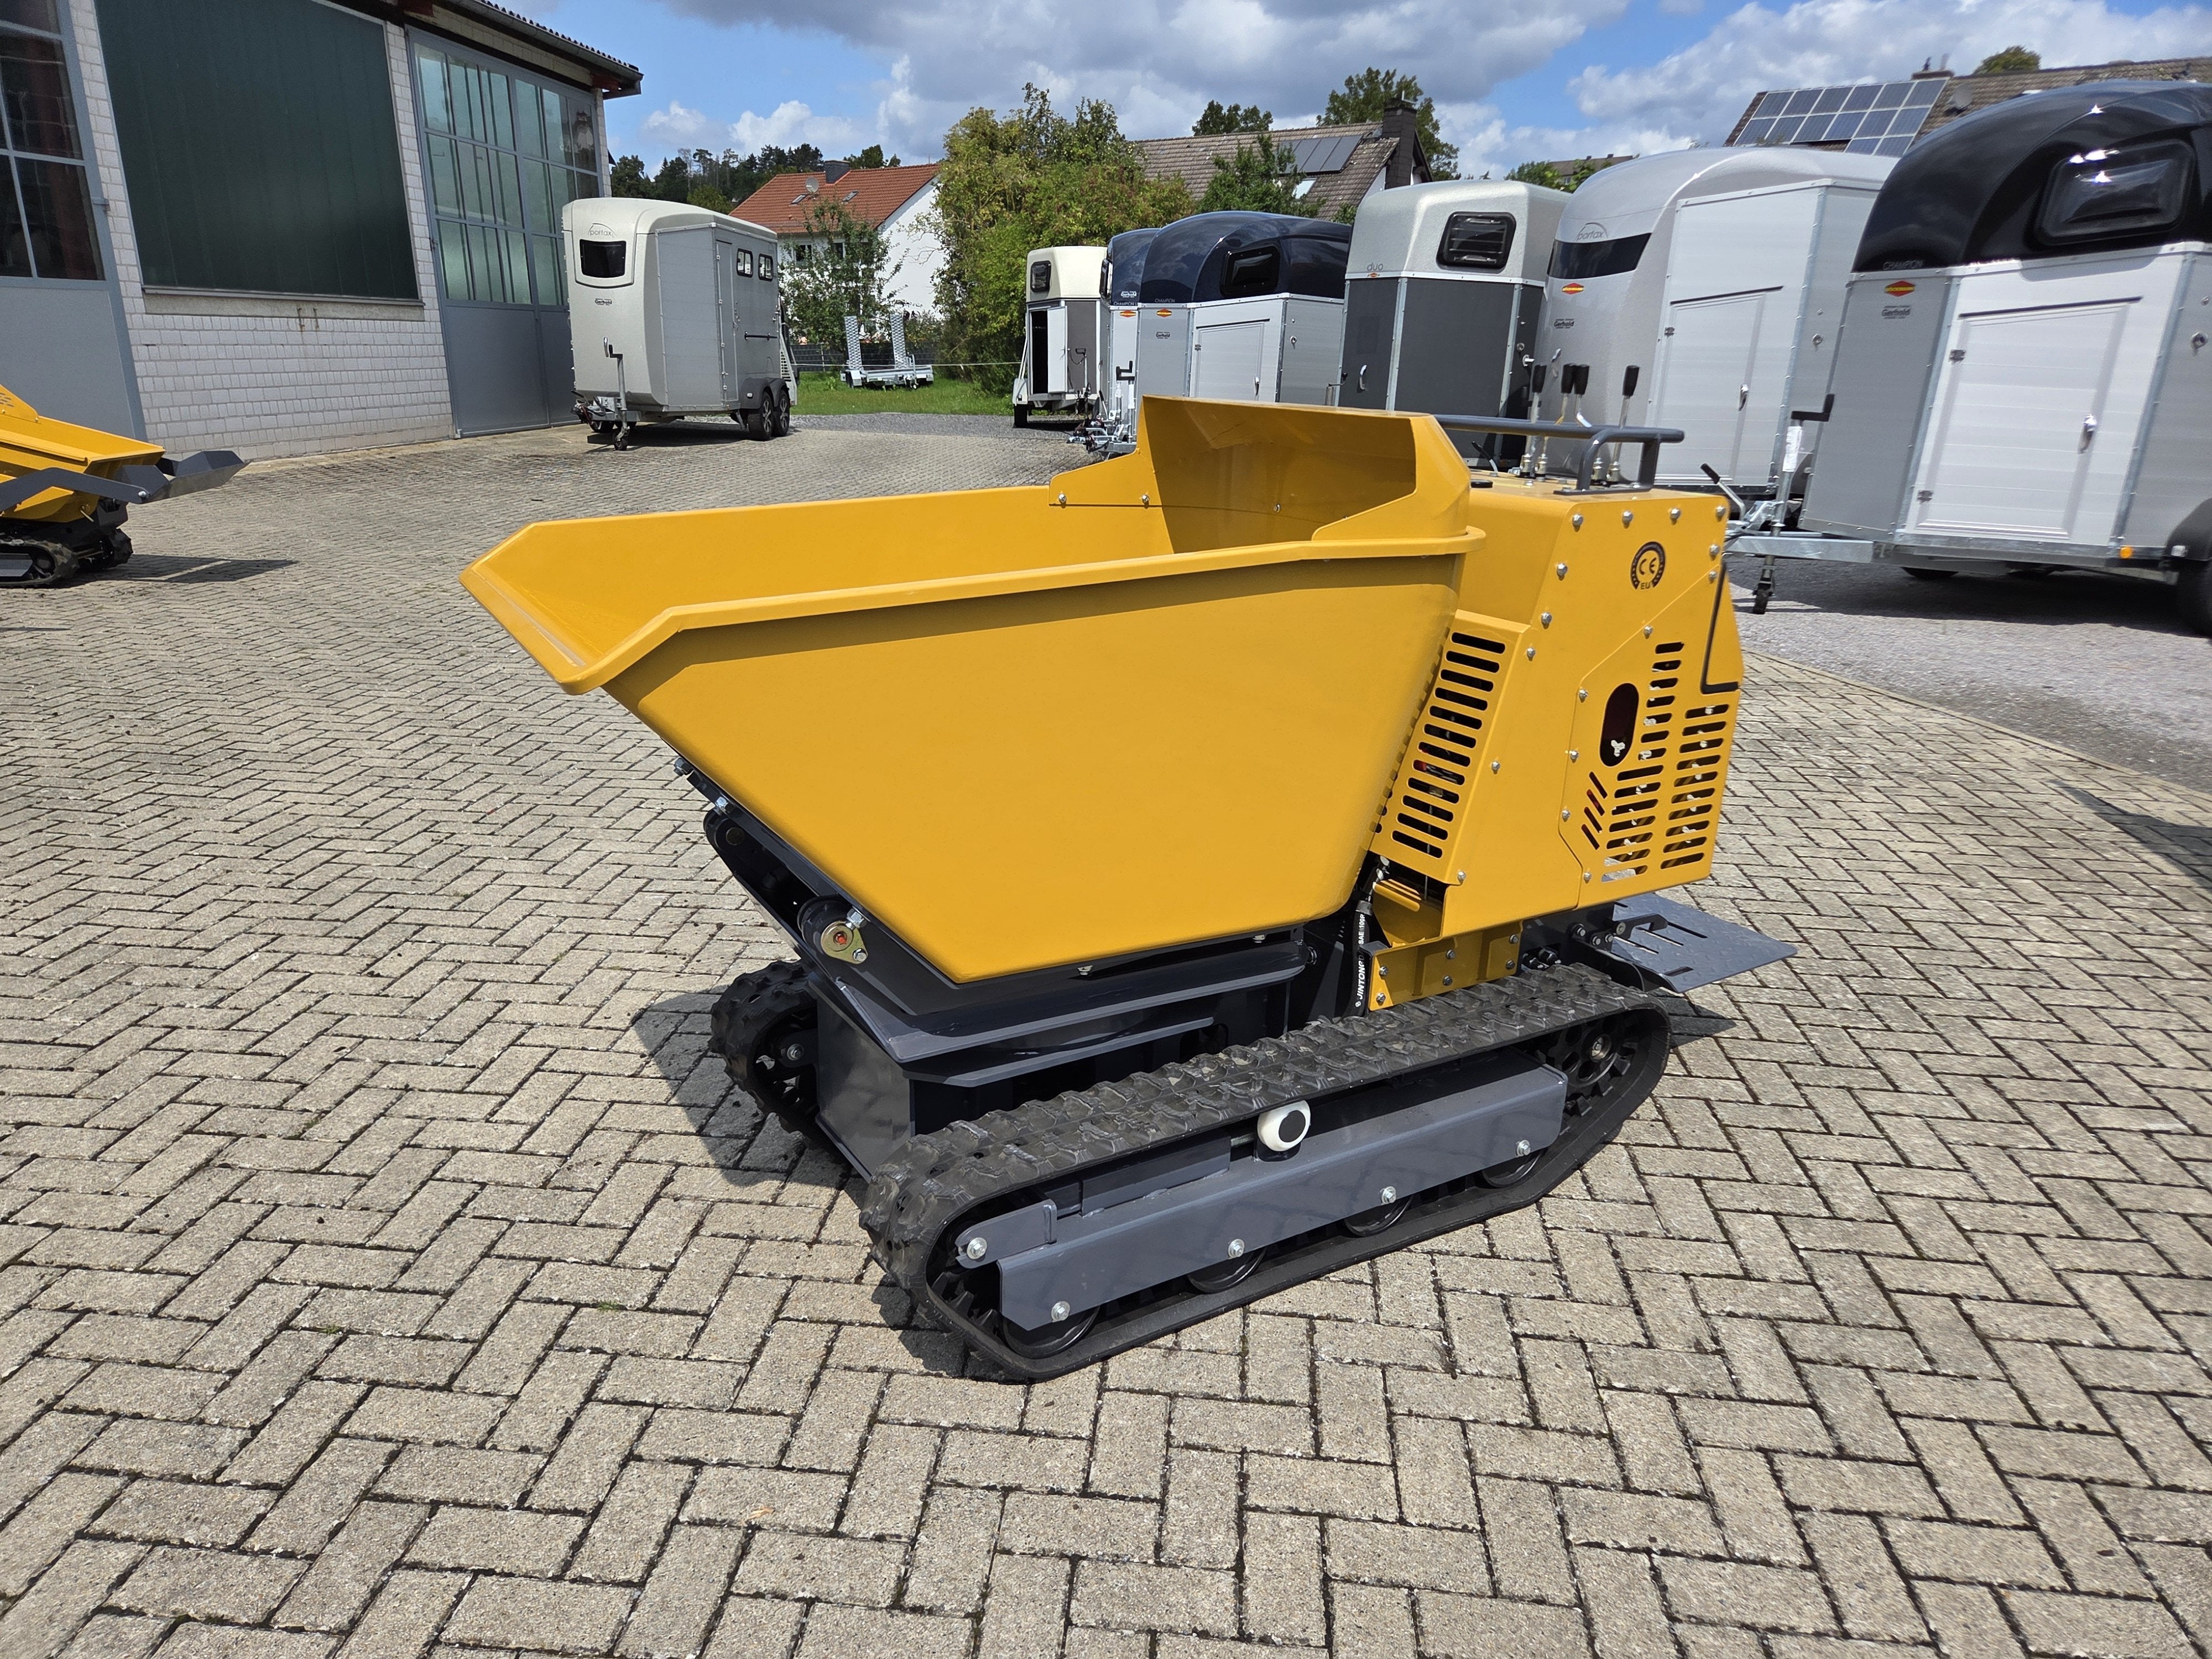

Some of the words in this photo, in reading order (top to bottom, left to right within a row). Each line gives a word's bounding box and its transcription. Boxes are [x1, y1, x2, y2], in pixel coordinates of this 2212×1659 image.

[1575, 230, 1604, 242] portax
[1367, 263, 1384, 271] duo
[1883, 260, 1924, 270] CHAMPION
[1639, 557, 1657, 575] CE
[1640, 581, 1651, 590] EU
